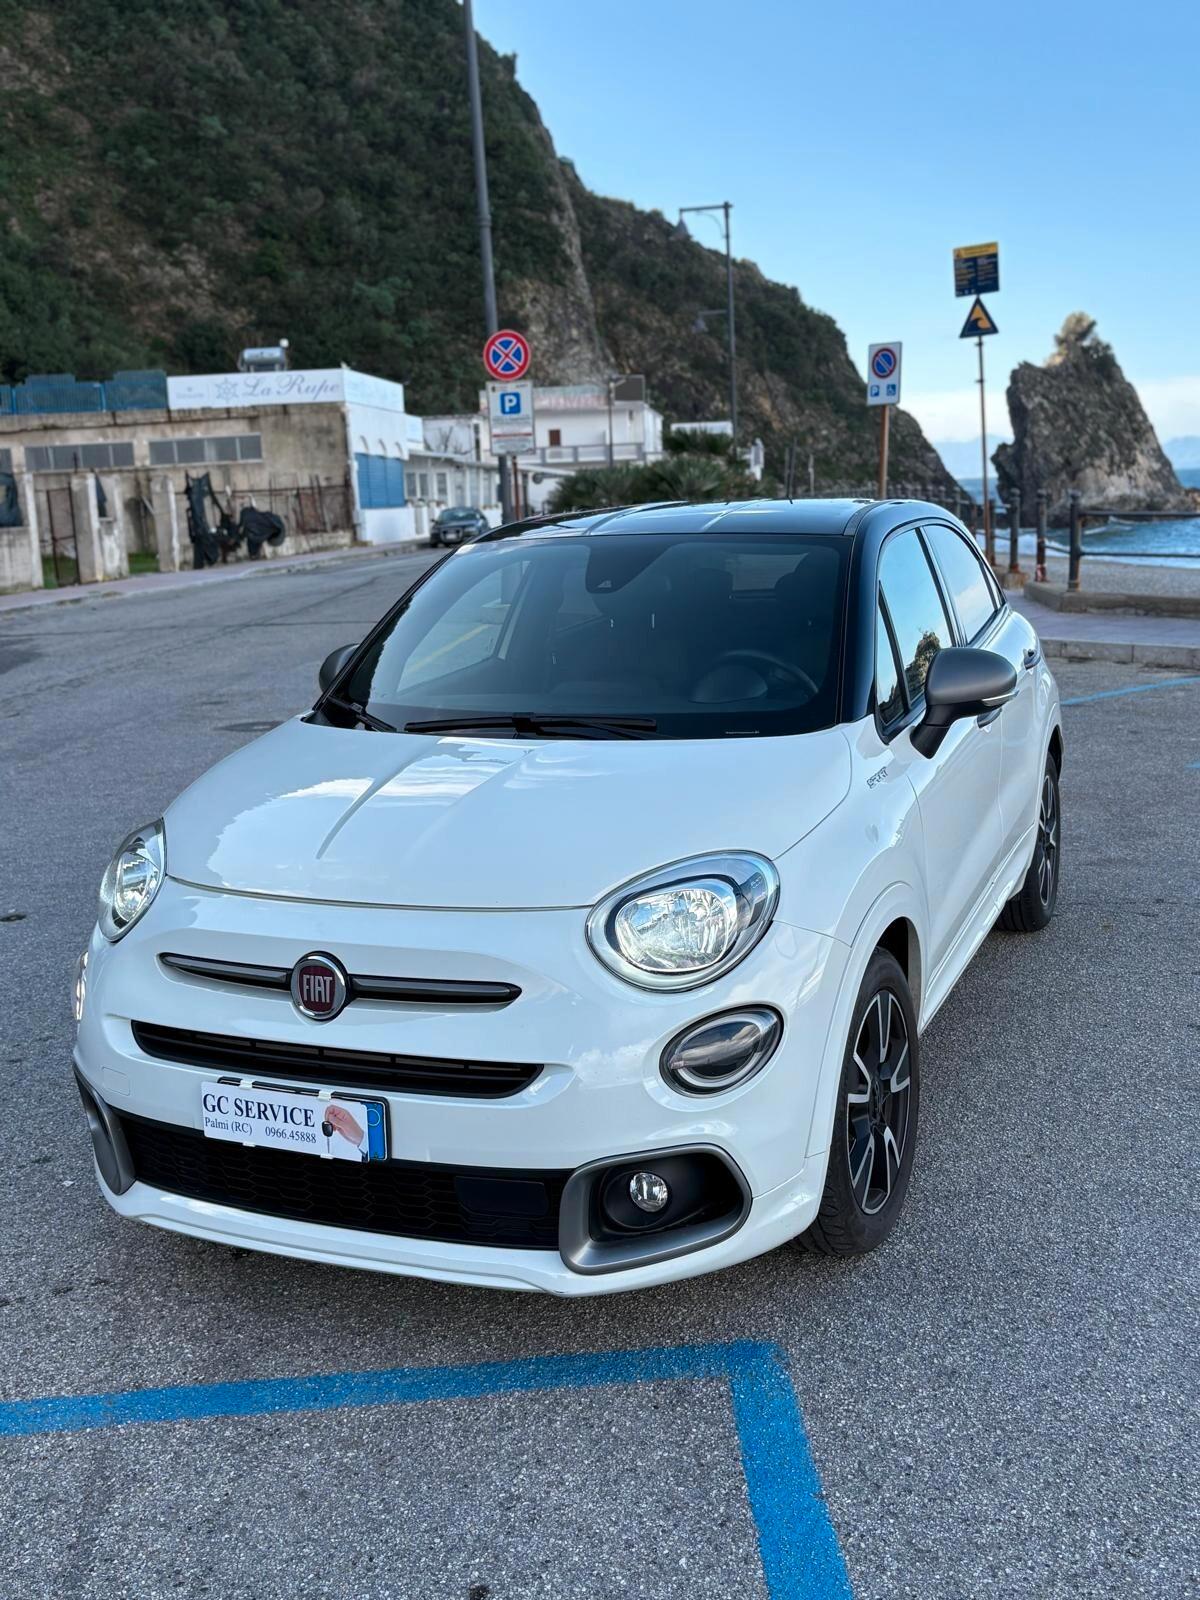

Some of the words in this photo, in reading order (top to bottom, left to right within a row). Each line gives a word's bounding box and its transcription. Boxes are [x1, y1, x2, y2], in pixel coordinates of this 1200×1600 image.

[277, 374, 339, 401] Rupe
[504, 394, 517, 412] P
[302, 974, 333, 1003] FIAT
[203, 1093, 230, 1114] GC
[234, 1097, 315, 1128] SERVICE
[205, 1117, 229, 1131] Palmi
[231, 1121, 253, 1136] (RC)
[265, 1126, 317, 1143] 0966.45888
